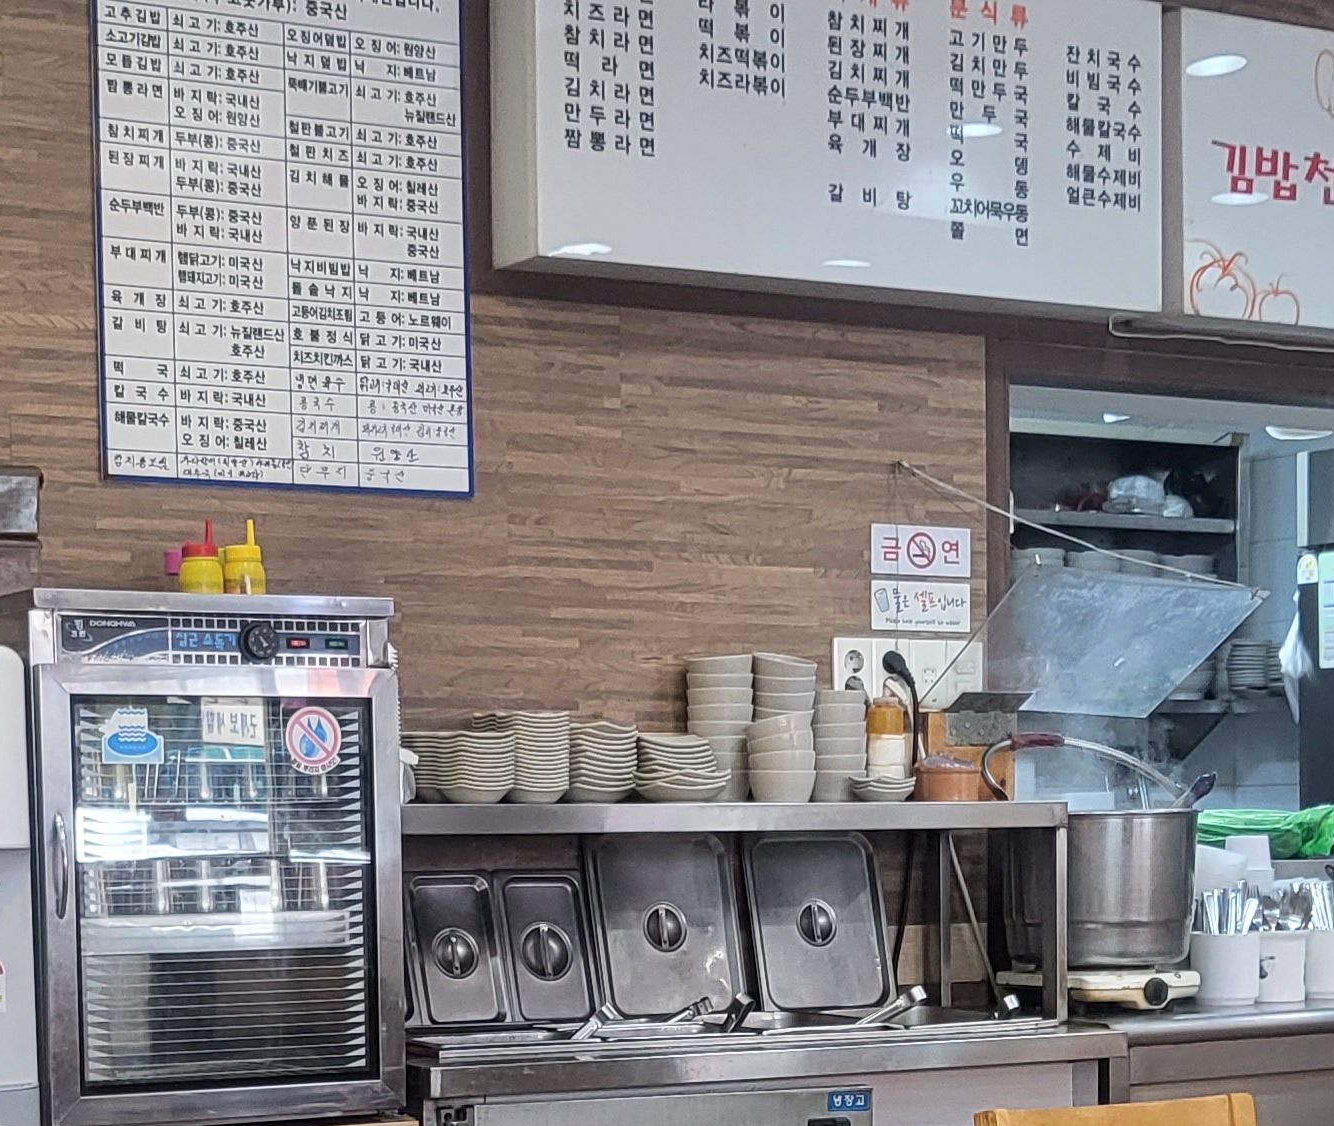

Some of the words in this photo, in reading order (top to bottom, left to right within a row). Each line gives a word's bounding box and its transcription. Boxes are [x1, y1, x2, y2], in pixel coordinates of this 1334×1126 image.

[105, 5, 160, 25] 고추김밥
[564, 0, 654, 30] 치즈라면
[225, 20, 258, 38] 호주산
[699, 18, 785, 48] 떡볶이
[828, 10, 909, 41] 참치찌개
[564, 25, 654, 55] 참치라면
[949, 30, 1028, 56] 고기만두
[225, 44, 259, 61] 호주산
[699, 43, 785, 73] 치즈떡볶이
[828, 35, 909, 66] 된장찌개
[1066, 45, 1142, 72] 잔치국수
[225, 68, 259, 84] 호주산
[564, 51, 654, 81] 떡라면
[828, 60, 909, 90] 김치찌개
[949, 53, 1028, 81] 김치만두
[564, 77, 654, 106] 김치라면
[699, 68, 785, 99] 치즈라볶이
[949, 77, 1028, 105] 떡만두국
[1066, 68, 1142, 96] 비빔국수
[404, 90, 437, 107] 호주산
[828, 84, 910, 113] 순두부백반
[1066, 92, 1142, 119] 칼국수
[564, 102, 654, 132] 만두라면
[828, 109, 910, 138] 부대찌개
[949, 100, 1028, 129] 만두국
[949, 124, 1028, 153] 떡국
[1066, 116, 1142, 143] 해물칼국수
[227, 137, 260, 153] 중국산
[405, 133, 437, 150] 호주산
[564, 128, 655, 158] 짬뽕라면
[828, 134, 911, 163] 육개장
[108, 150, 165, 169] 된장찌개
[1066, 139, 1142, 166] 수제비
[228, 163, 261, 179] 국내산
[405, 156, 438, 172] 호주산
[949, 149, 1029, 177] 오뎅
[949, 172, 1029, 200] 우동
[1066, 163, 1142, 190] 해물수제비
[228, 181, 261, 197] 중국산
[828, 183, 911, 210] 갈비탕
[109, 198, 165, 216] 순두부백반
[407, 198, 438, 214] 중국산
[1066, 186, 1142, 213] 얼큰수제비
[228, 210, 262, 226] 중국산
[950, 197, 1029, 224] 꼬치어묵우동
[229, 229, 262, 244] 국내산
[407, 225, 439, 242] 국내산
[950, 221, 1029, 247] 쫄면
[110, 245, 166, 264] 부대찌개
[407, 244, 439, 259] 중국산
[228, 258, 263, 272] 미국산
[290, 258, 351, 276] 낙지비빔밥
[229, 274, 263, 290] 미국산
[408, 269, 440, 284] 베트남
[111, 290, 166, 308] 육개장
[178, 295, 226, 312] 쇠고기:
[230, 300, 264, 316] 호주산
[408, 291, 440, 306] 베트남
[292, 305, 353, 322] 고등어김치조림
[359, 310, 405, 327] 고등어:
[409, 314, 451, 330] 노르웨이
[112, 316, 167, 334] 갈비탕
[179, 322, 226, 338] 쇠고기:
[230, 326, 284, 342] 뉴질랜드산
[231, 344, 265, 358] 호주산
[360, 333, 405, 350] 닭고기:
[409, 337, 441, 350] 미국산
[293, 349, 354, 368] 치즈치킨까스
[360, 355, 406, 371] 닭고기:
[410, 358, 442, 374] 국내산
[114, 361, 168, 378] 떡국
[180, 365, 227, 380] 쇠고기:
[231, 369, 265, 385] 호주산
[115, 385, 169, 402] 칼국수
[180, 389, 228, 404] 바지락:
[232, 393, 266, 408] 국내산
[115, 411, 170, 427] 해물칼국수
[181, 415, 229, 431] 바지락:
[233, 418, 267, 433] 중국산
[182, 433, 229, 448] 오징어:
[233, 436, 267, 451] 칠레산
